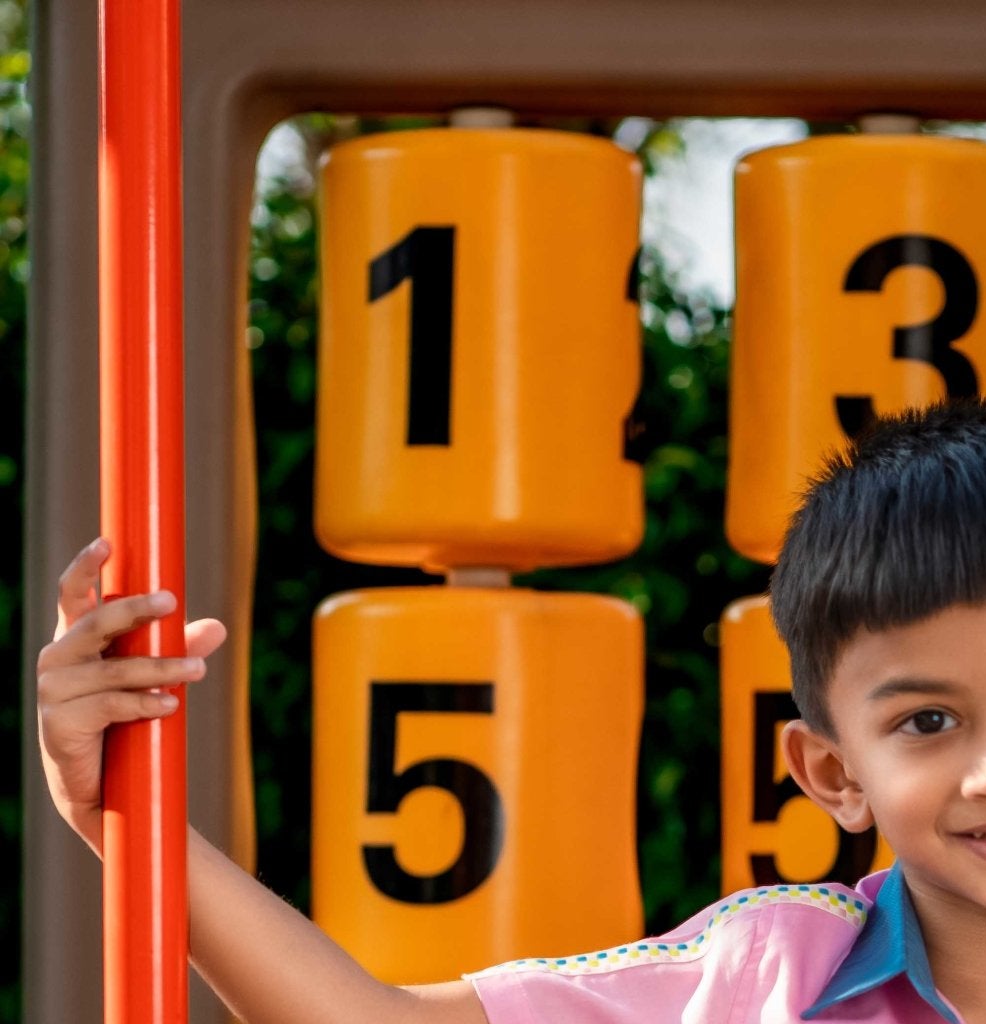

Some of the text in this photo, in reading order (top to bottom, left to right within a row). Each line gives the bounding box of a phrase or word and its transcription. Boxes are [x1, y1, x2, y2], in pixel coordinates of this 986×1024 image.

[367, 224, 457, 447] 1
[834, 233, 980, 438] 3
[361, 681, 505, 905] 5
